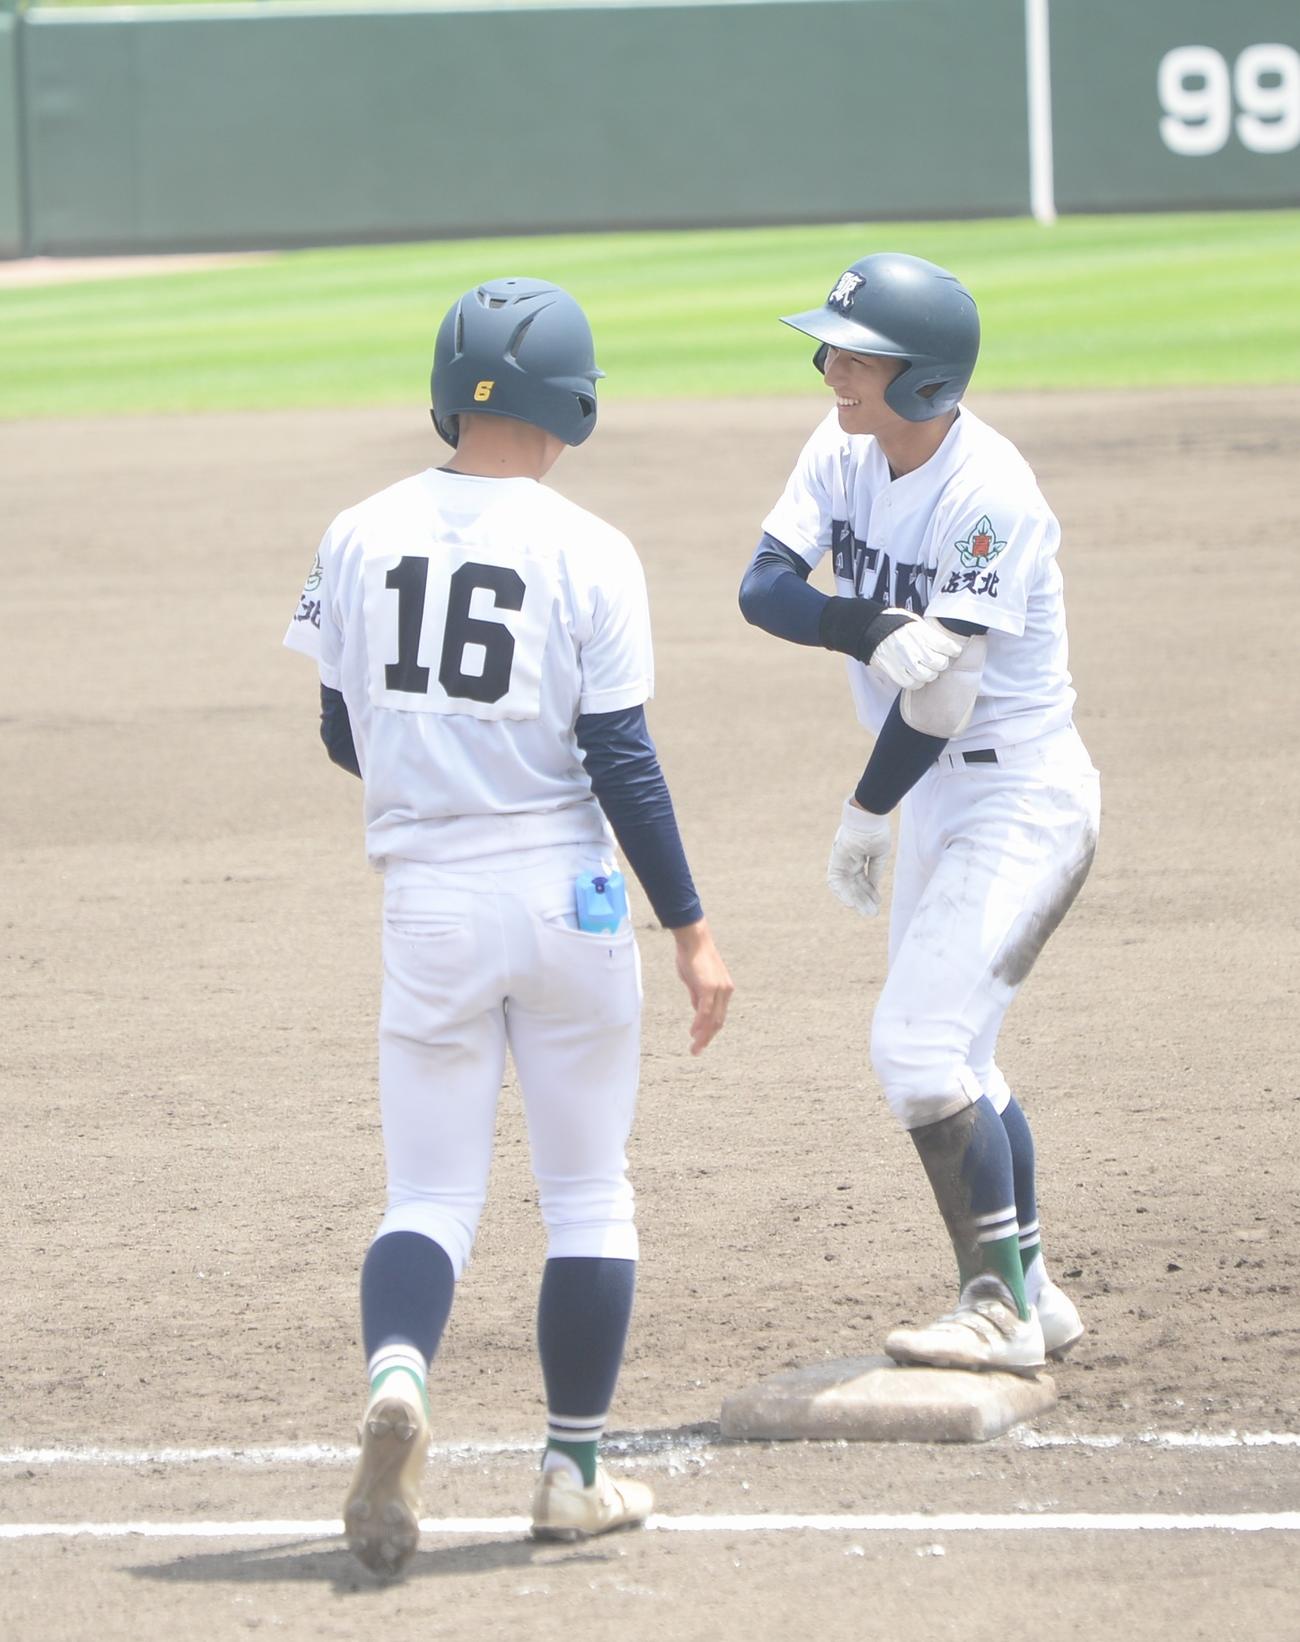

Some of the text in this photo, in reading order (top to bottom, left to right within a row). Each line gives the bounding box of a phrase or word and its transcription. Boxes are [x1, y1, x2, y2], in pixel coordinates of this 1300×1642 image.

[1157, 43, 1300, 155] 99
[473, 380, 495, 402] 6
[385, 555, 526, 704] 16
